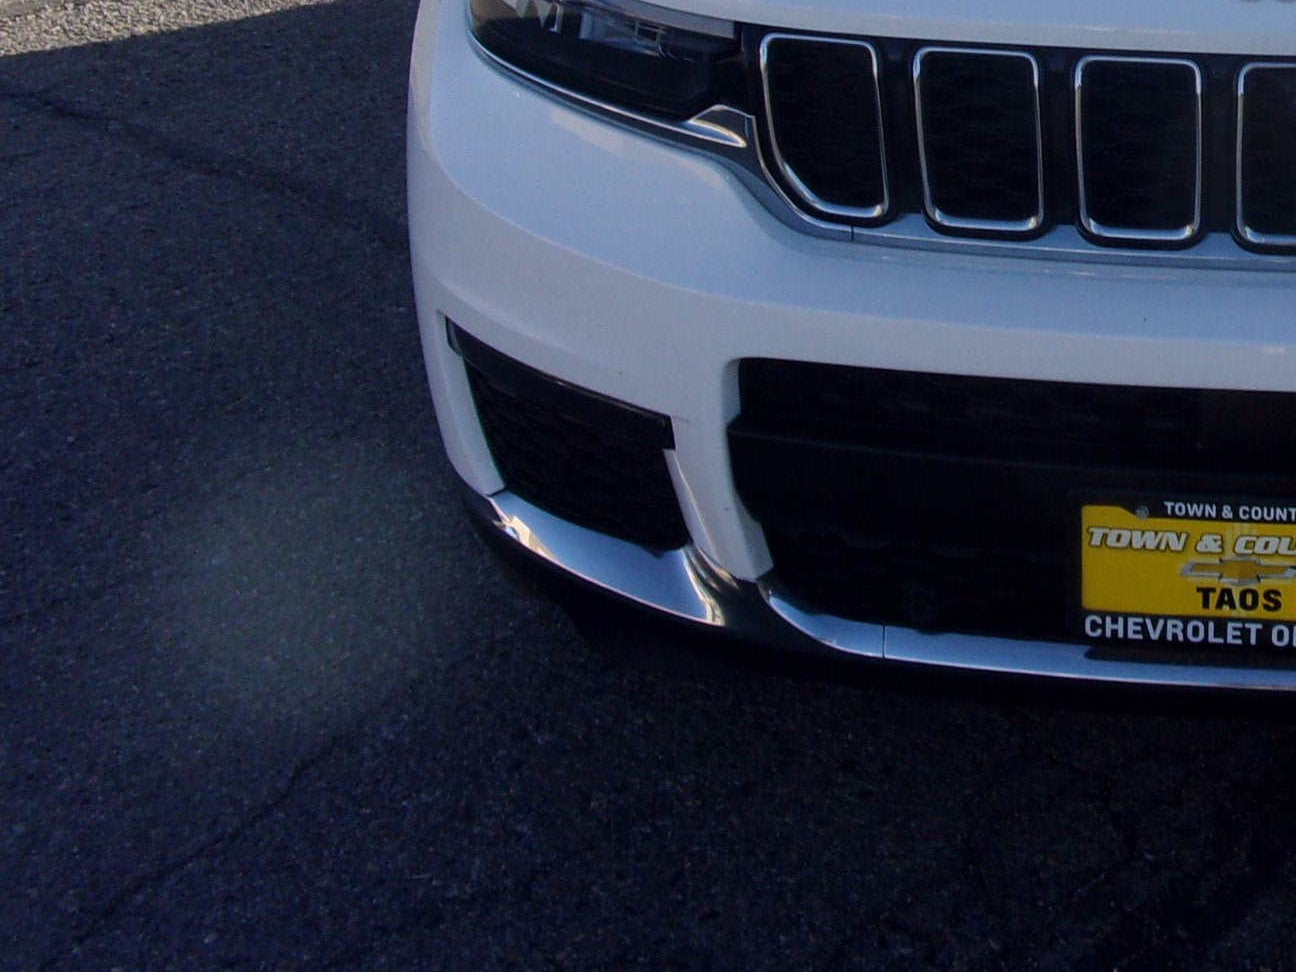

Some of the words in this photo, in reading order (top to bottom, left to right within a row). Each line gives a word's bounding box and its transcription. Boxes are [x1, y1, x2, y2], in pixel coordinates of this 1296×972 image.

[1164, 501, 1217, 518] TOWN
[1221, 504, 1234, 519] &
[1086, 526, 1188, 551] TOWN
[1195, 533, 1224, 554] &
[1196, 586, 1282, 612] TAOS
[1084, 614, 1262, 645] CHEVROLET
